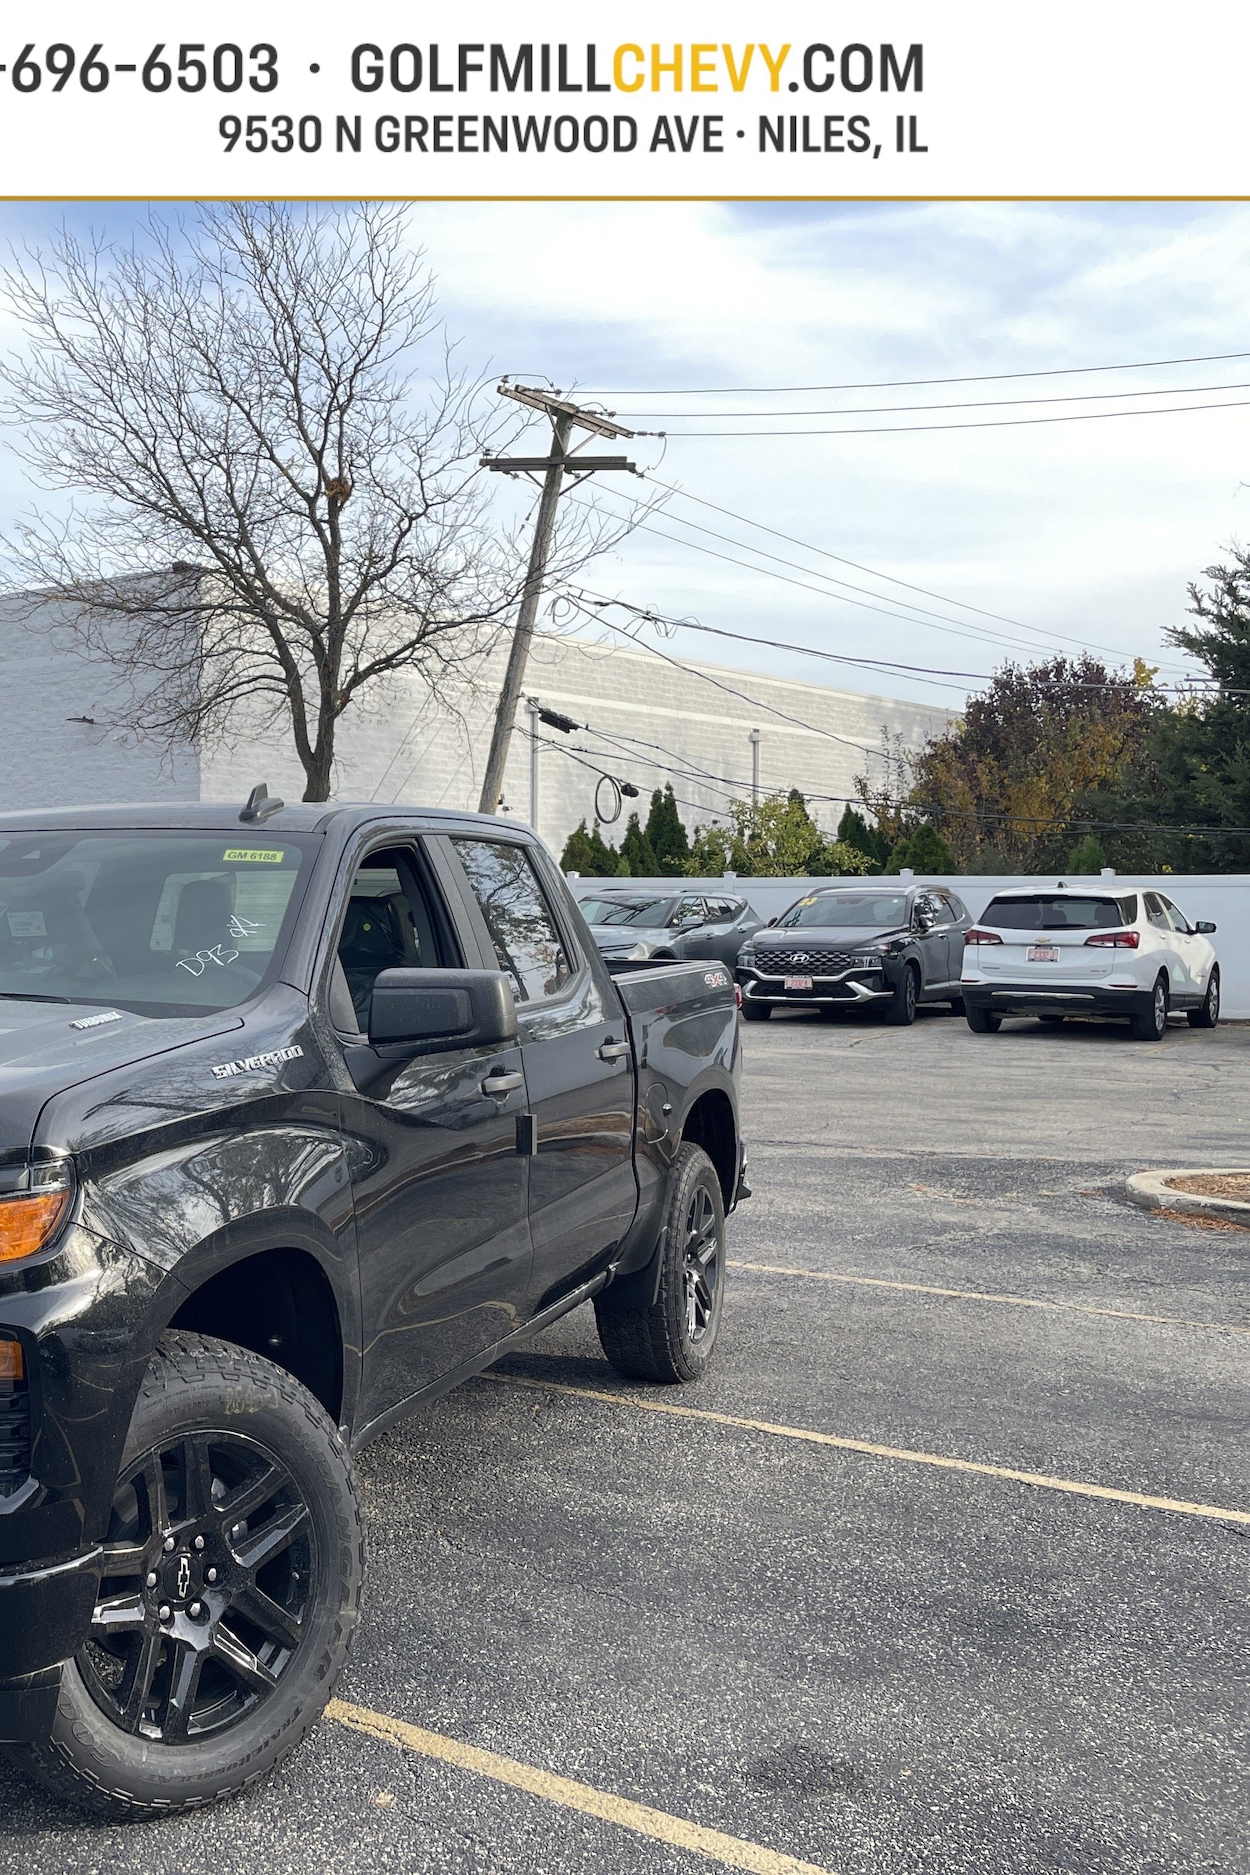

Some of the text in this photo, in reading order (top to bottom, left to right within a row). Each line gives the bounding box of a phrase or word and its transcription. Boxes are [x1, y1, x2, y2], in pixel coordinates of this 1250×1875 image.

[227, 851, 277, 861] GM 6188
[175, 943, 239, 976] D93
[210, 1045, 304, 1080] SILVERADO
